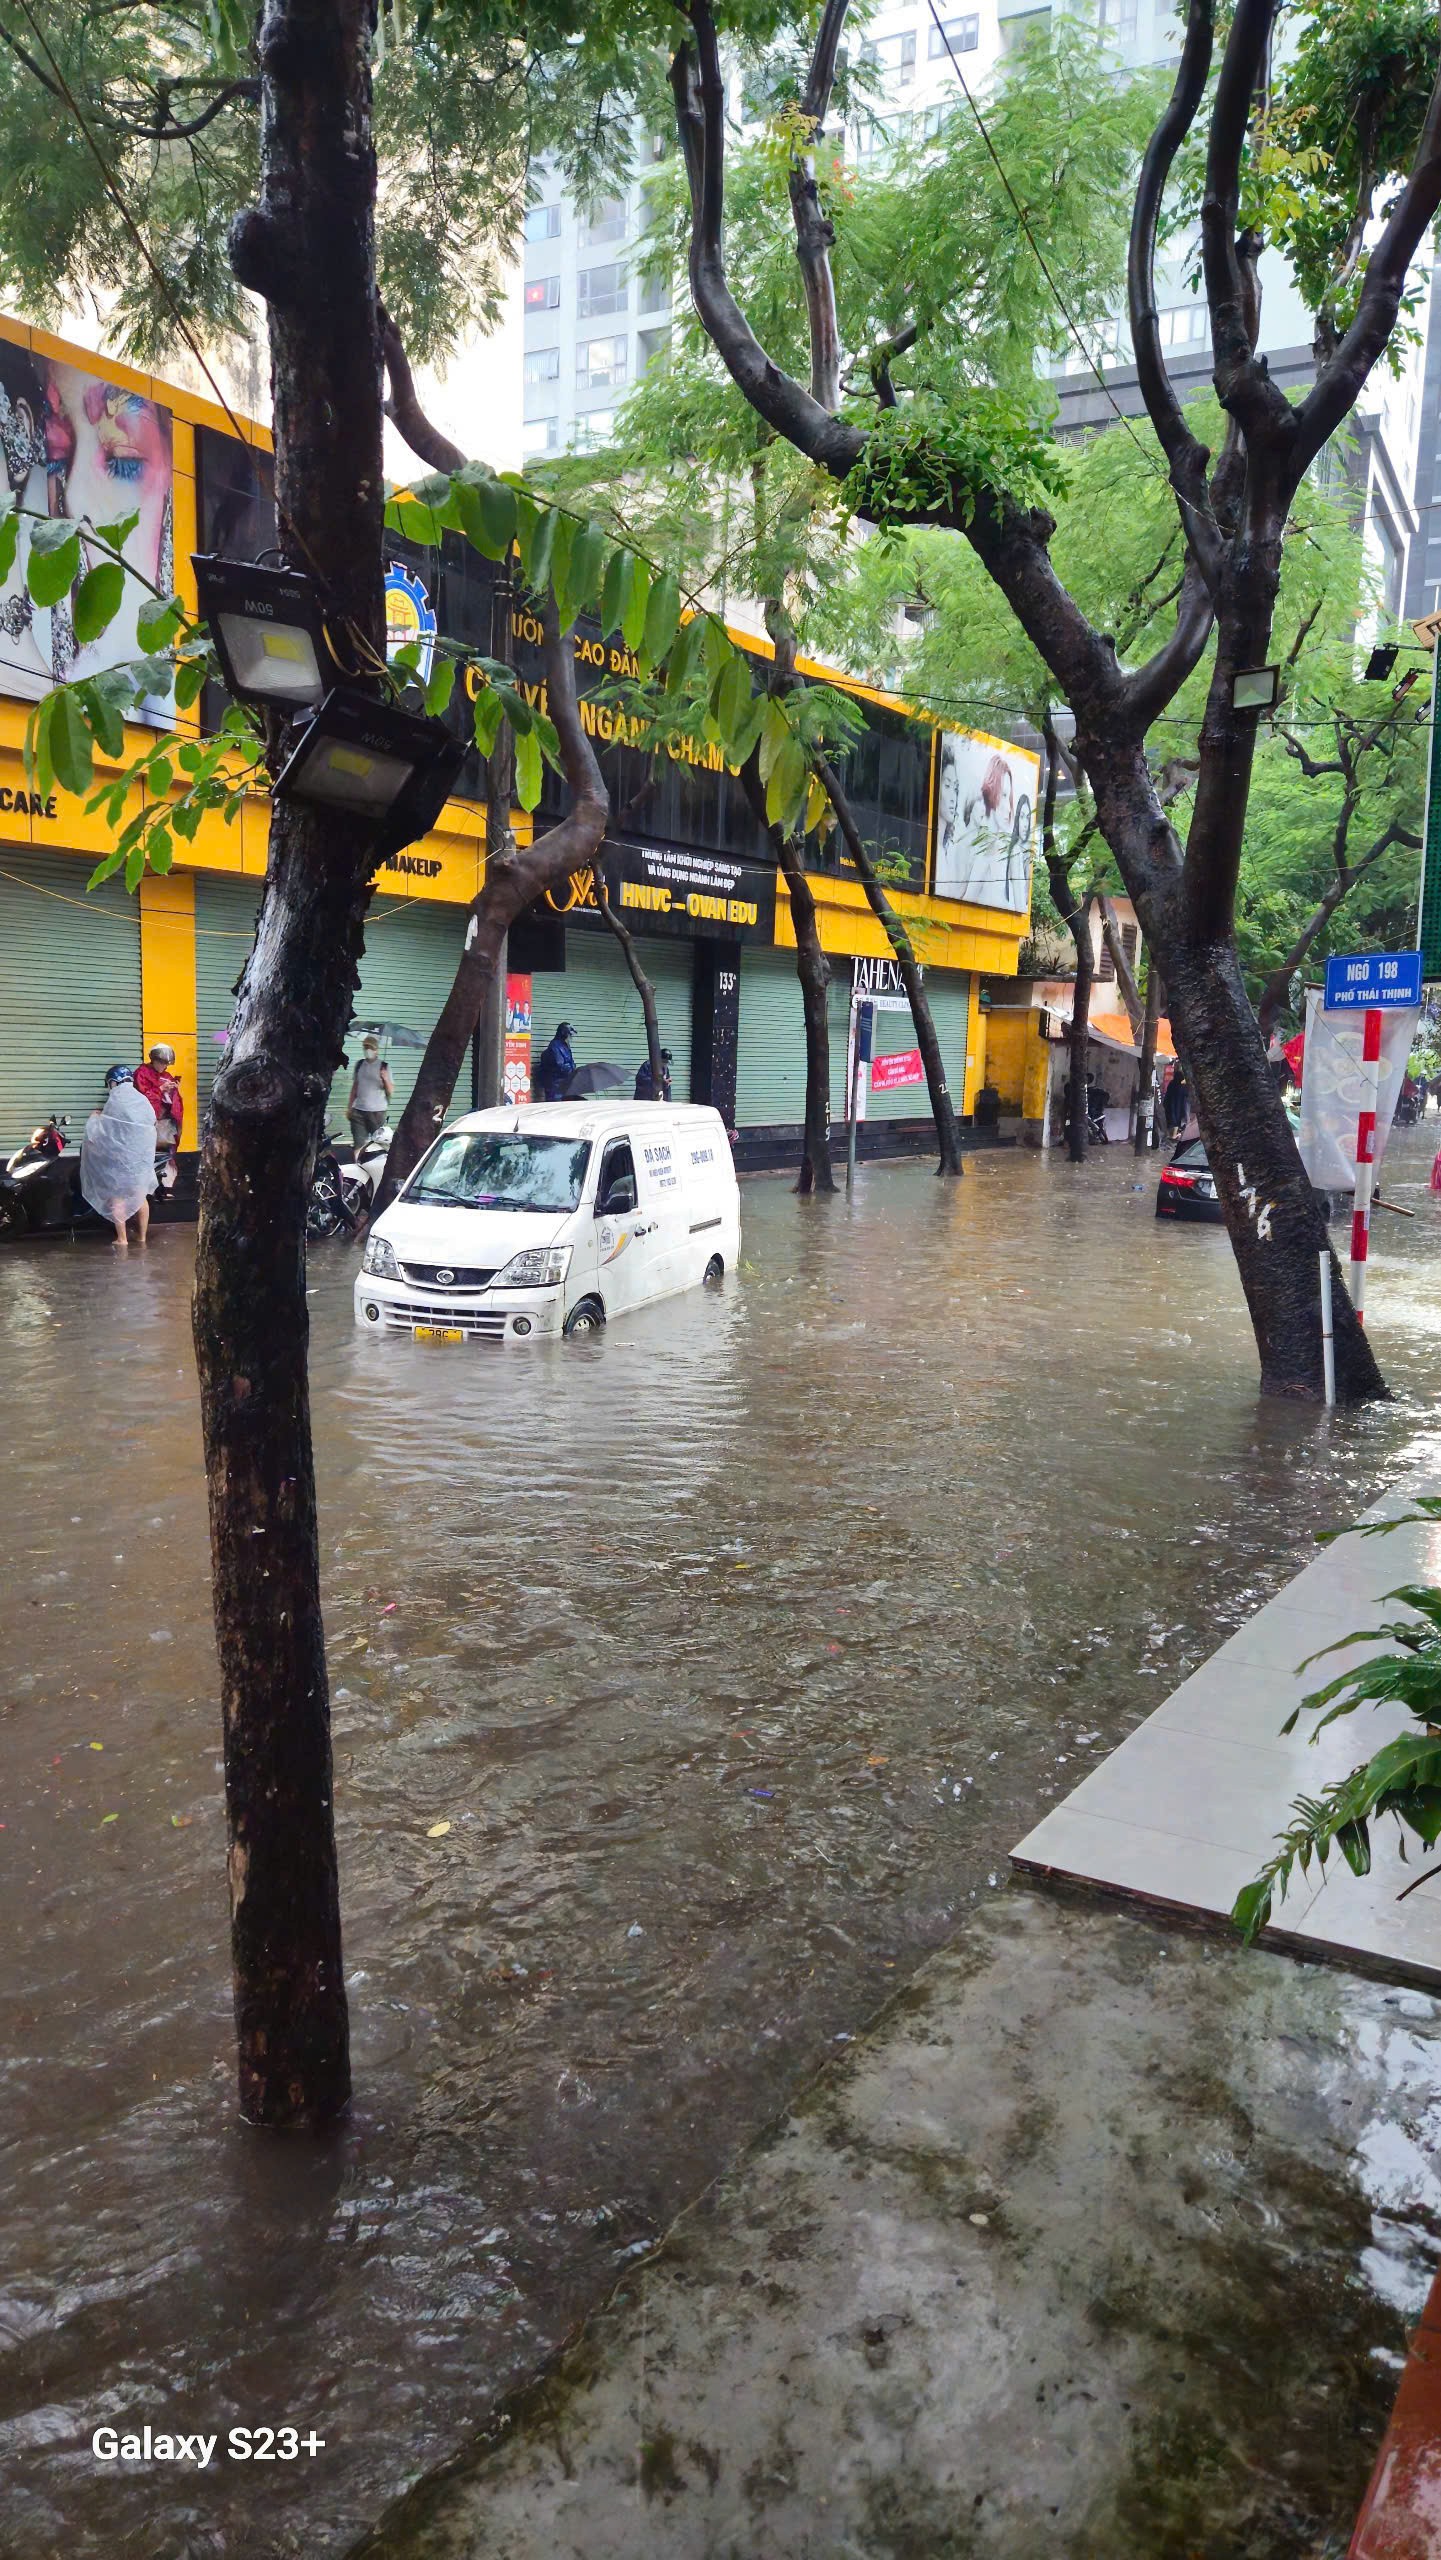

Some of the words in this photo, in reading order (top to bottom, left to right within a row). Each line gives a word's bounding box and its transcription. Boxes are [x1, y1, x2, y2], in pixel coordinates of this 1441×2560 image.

[0, 788, 57, 818] CARE
[386, 855, 442, 877] MAKEUP
[620, 881, 672, 912] HNIVC
[687, 893, 727, 921] OVAN
[727, 899, 758, 925] EDU
[1347, 960, 1370, 981] NGÕ
[1378, 961, 1398, 979] 198
[1334, 988, 1356, 1002] PHỐ
[1357, 988, 1380, 1000] THÁI
[1382, 987, 1412, 1002] THỊNH
